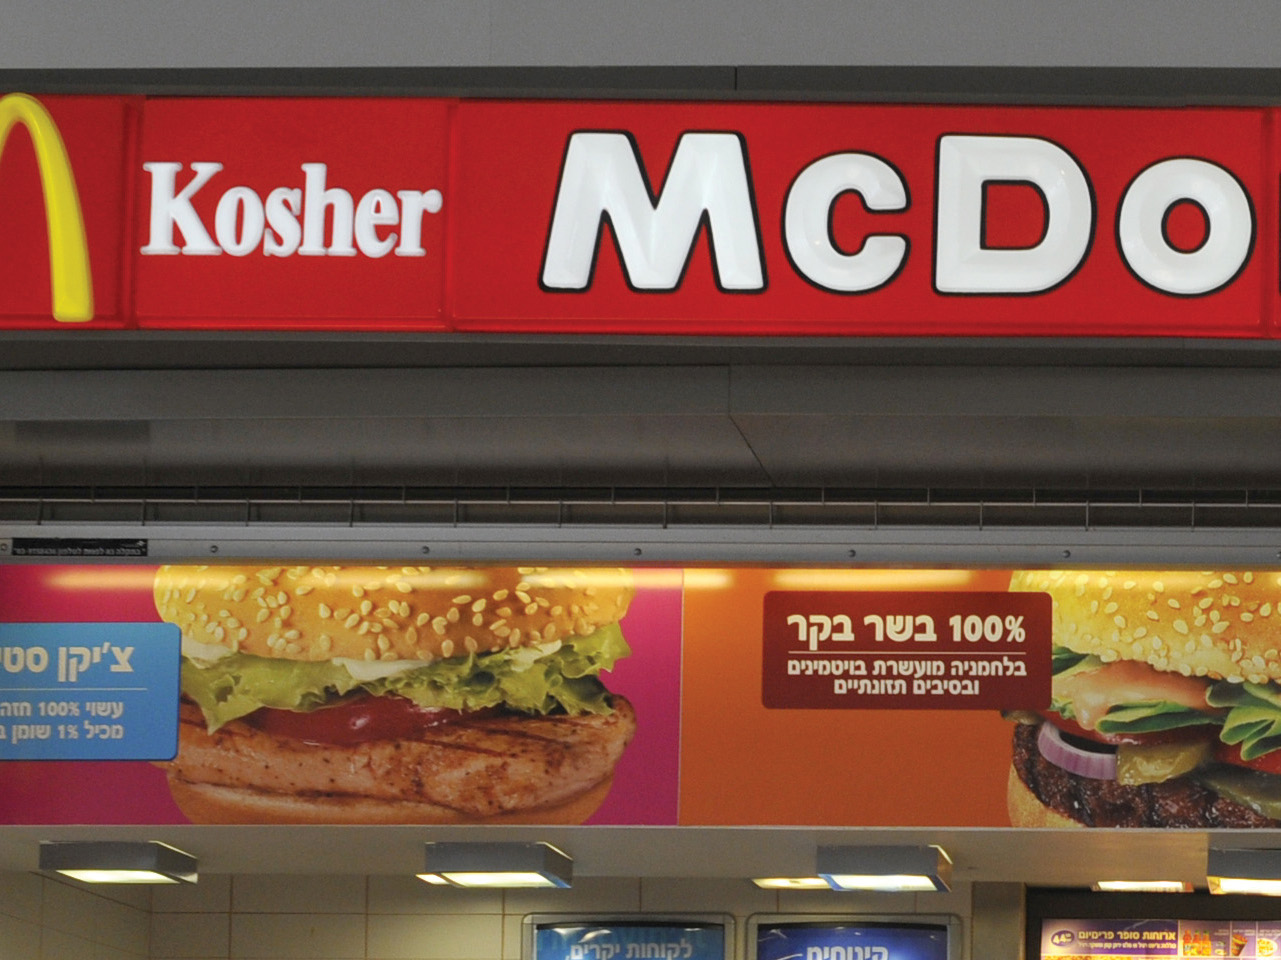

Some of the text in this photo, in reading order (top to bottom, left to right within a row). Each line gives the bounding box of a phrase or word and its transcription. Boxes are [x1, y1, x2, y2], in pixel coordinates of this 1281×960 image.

[140, 161, 442, 260] Kosher
[787, 614, 1026, 651] 100% בשר בקר
[787, 656, 1027, 677] בלחמניה מועשרת בויטמינים
[834, 679, 979, 695] ובסיבים תזונתיים
[39, 701, 80, 717] 100%
[86, 702, 124, 719] עשוי
[12, 724, 52, 745] שומן
[58, 724, 79, 739] 1%
[84, 720, 124, 739] מכיל
[1117, 930, 1140, 940] סופר
[1142, 931, 1176, 940] ארוחות
